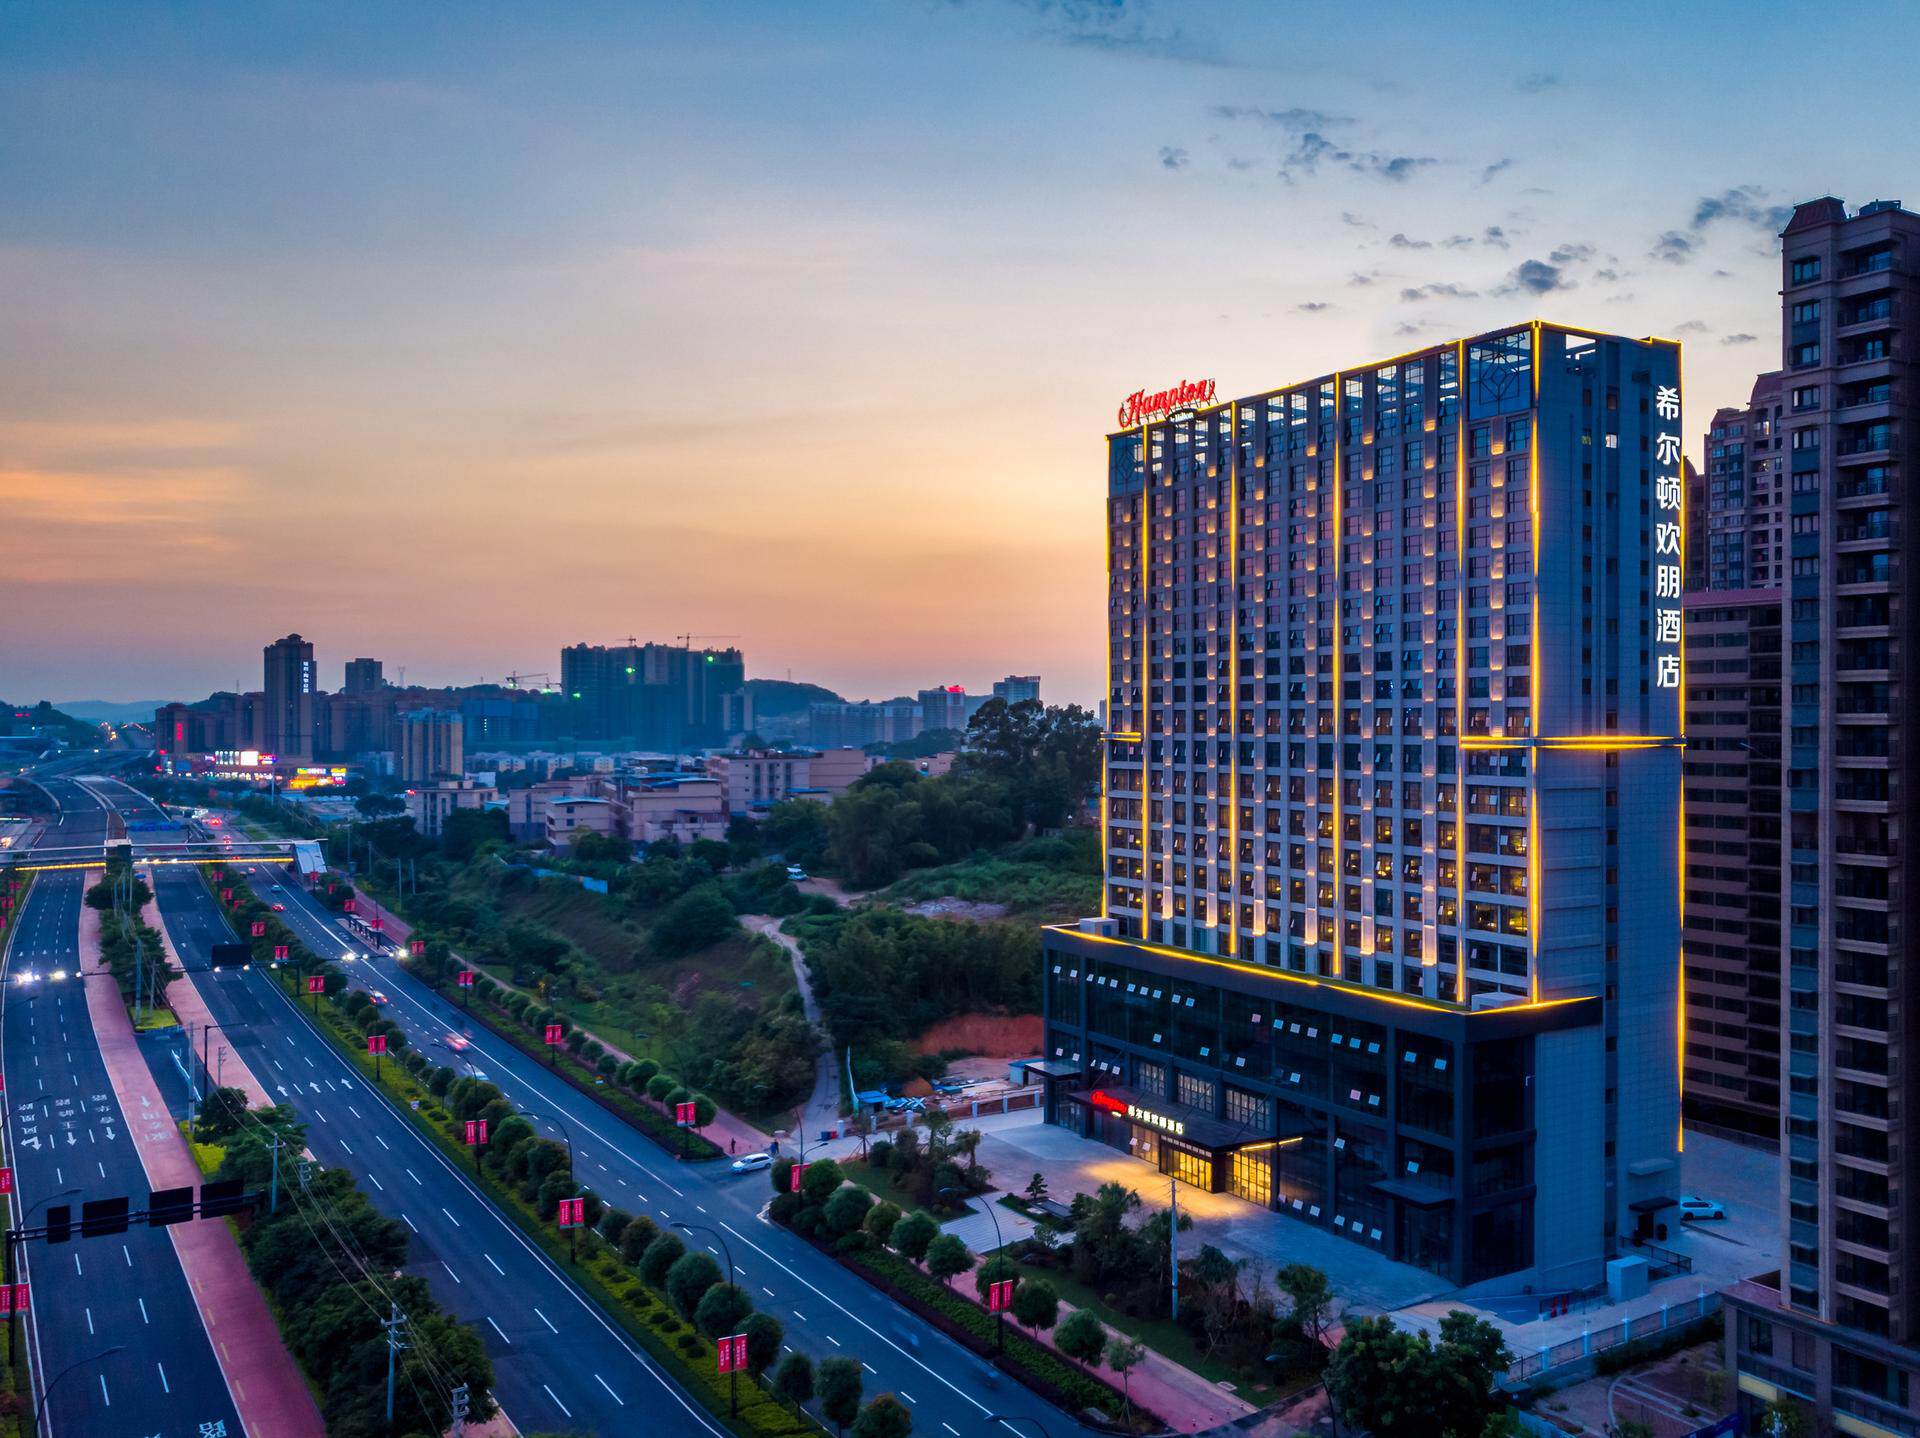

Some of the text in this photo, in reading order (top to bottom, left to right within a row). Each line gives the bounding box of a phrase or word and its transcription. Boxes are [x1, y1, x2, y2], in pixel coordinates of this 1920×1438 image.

[1118, 378, 1215, 427] Hampton
[1656, 385, 1681, 688] 希尔顿欢朋酒店
